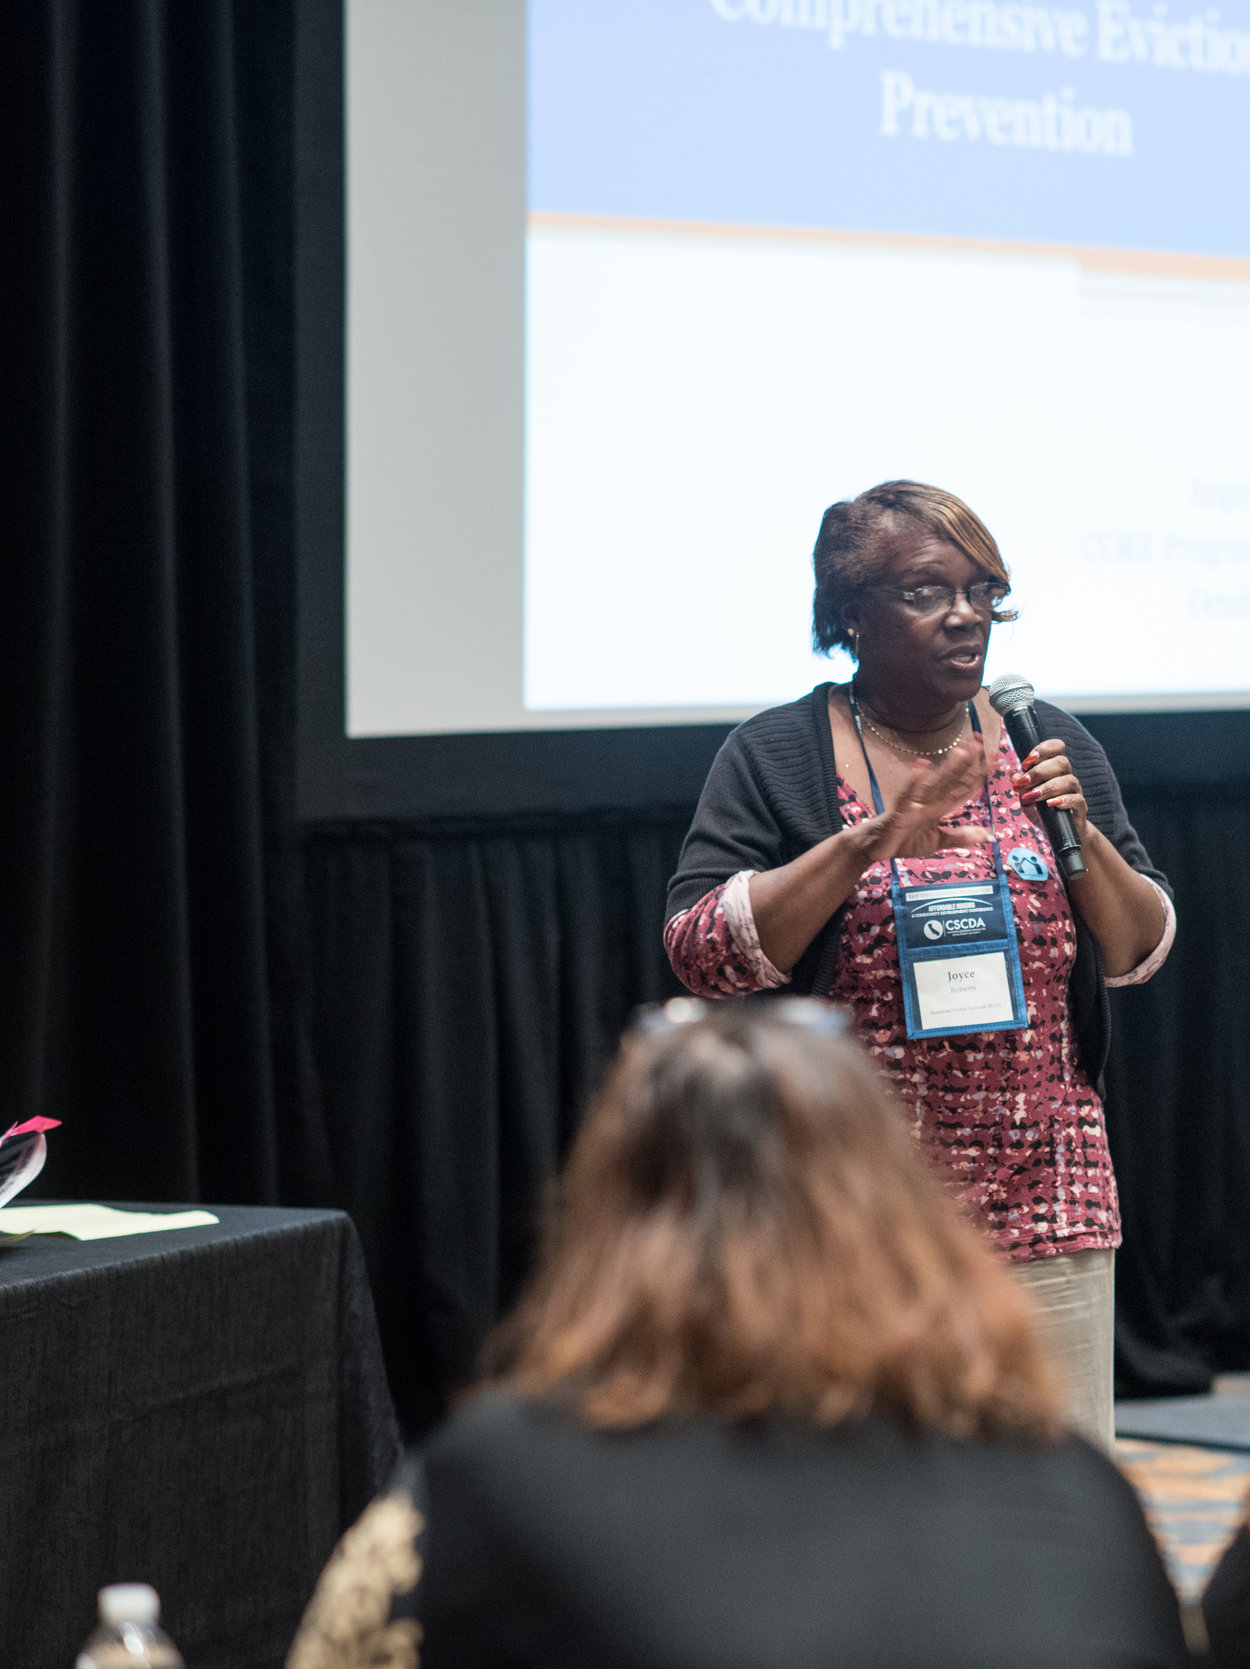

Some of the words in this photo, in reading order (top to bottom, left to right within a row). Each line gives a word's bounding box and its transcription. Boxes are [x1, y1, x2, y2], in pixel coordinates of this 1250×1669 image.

[880, 71, 1134, 156] Prevention
[945, 917, 986, 930] CSCDA
[948, 971, 975, 983] Joyce
